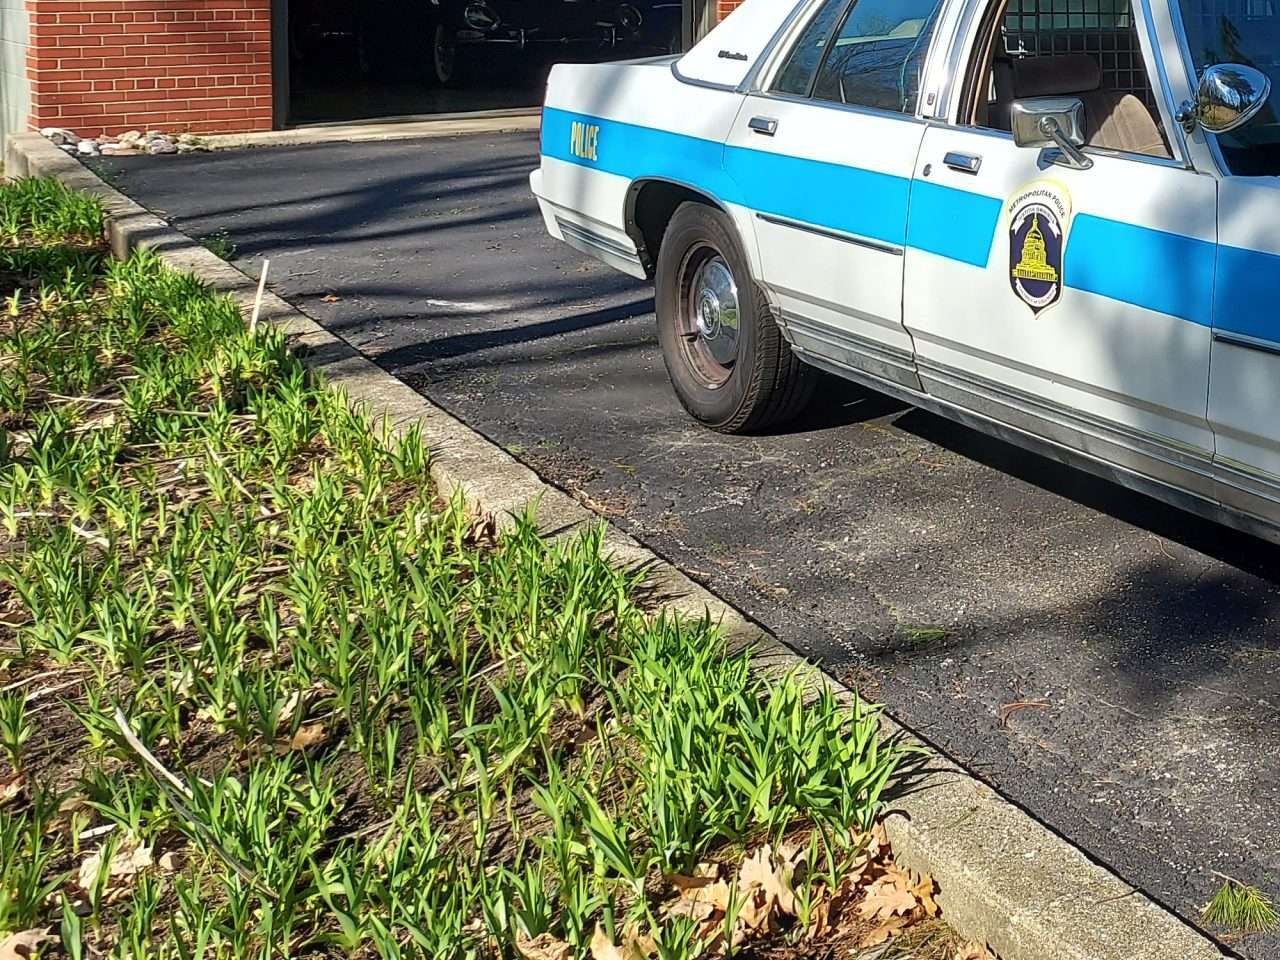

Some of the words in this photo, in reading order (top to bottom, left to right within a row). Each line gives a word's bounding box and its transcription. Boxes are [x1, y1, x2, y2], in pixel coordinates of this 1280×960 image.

[570, 121, 599, 161] POLICE
[1009, 189, 1053, 213] METROPOLITAN
[1052, 195, 1066, 218] POLICE
